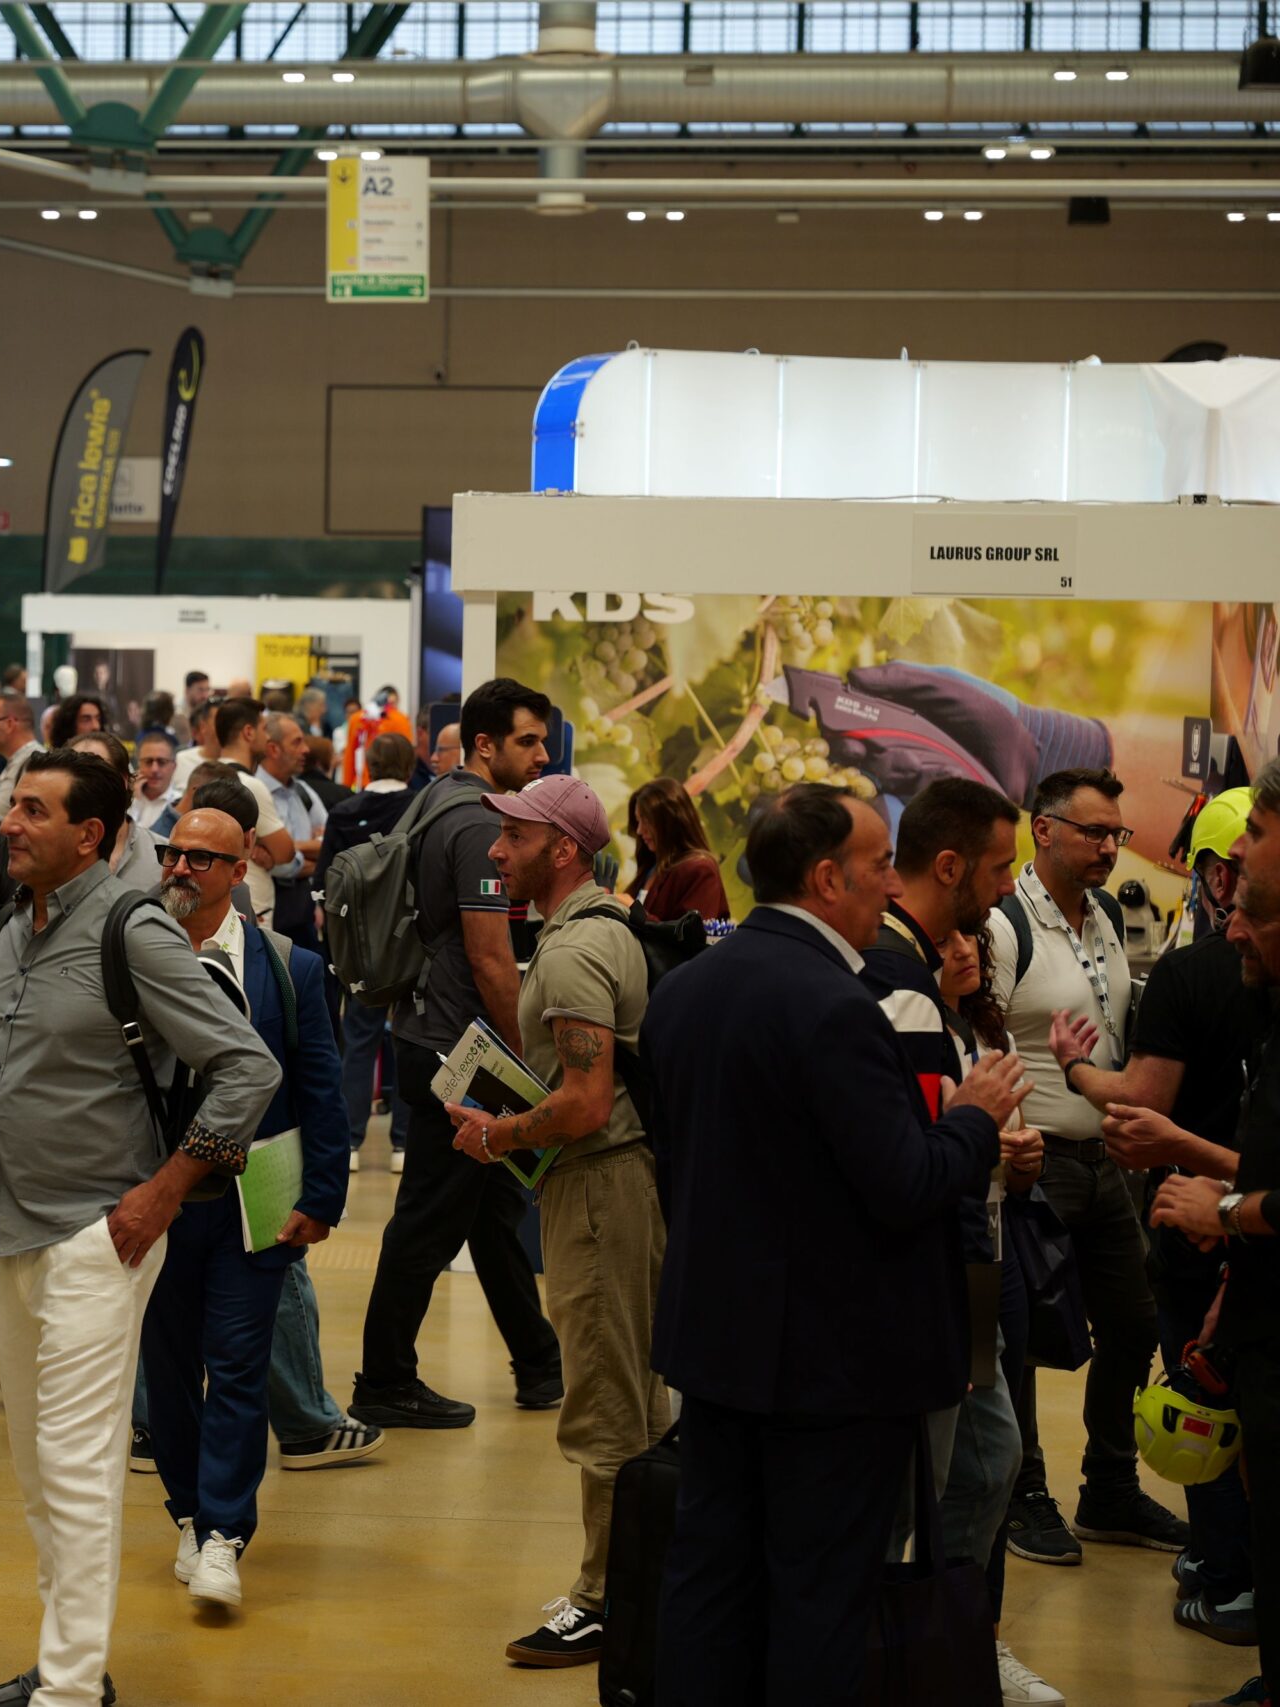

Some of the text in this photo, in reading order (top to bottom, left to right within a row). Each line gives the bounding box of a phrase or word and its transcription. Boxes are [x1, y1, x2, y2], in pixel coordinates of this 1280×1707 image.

[363, 177, 394, 196] A2
[70, 398, 112, 528] rica lewis
[930, 546, 1060, 562] LAURUS GROUP SRL
[1060, 576, 1073, 588] 51
[533, 592, 696, 624] KDS
